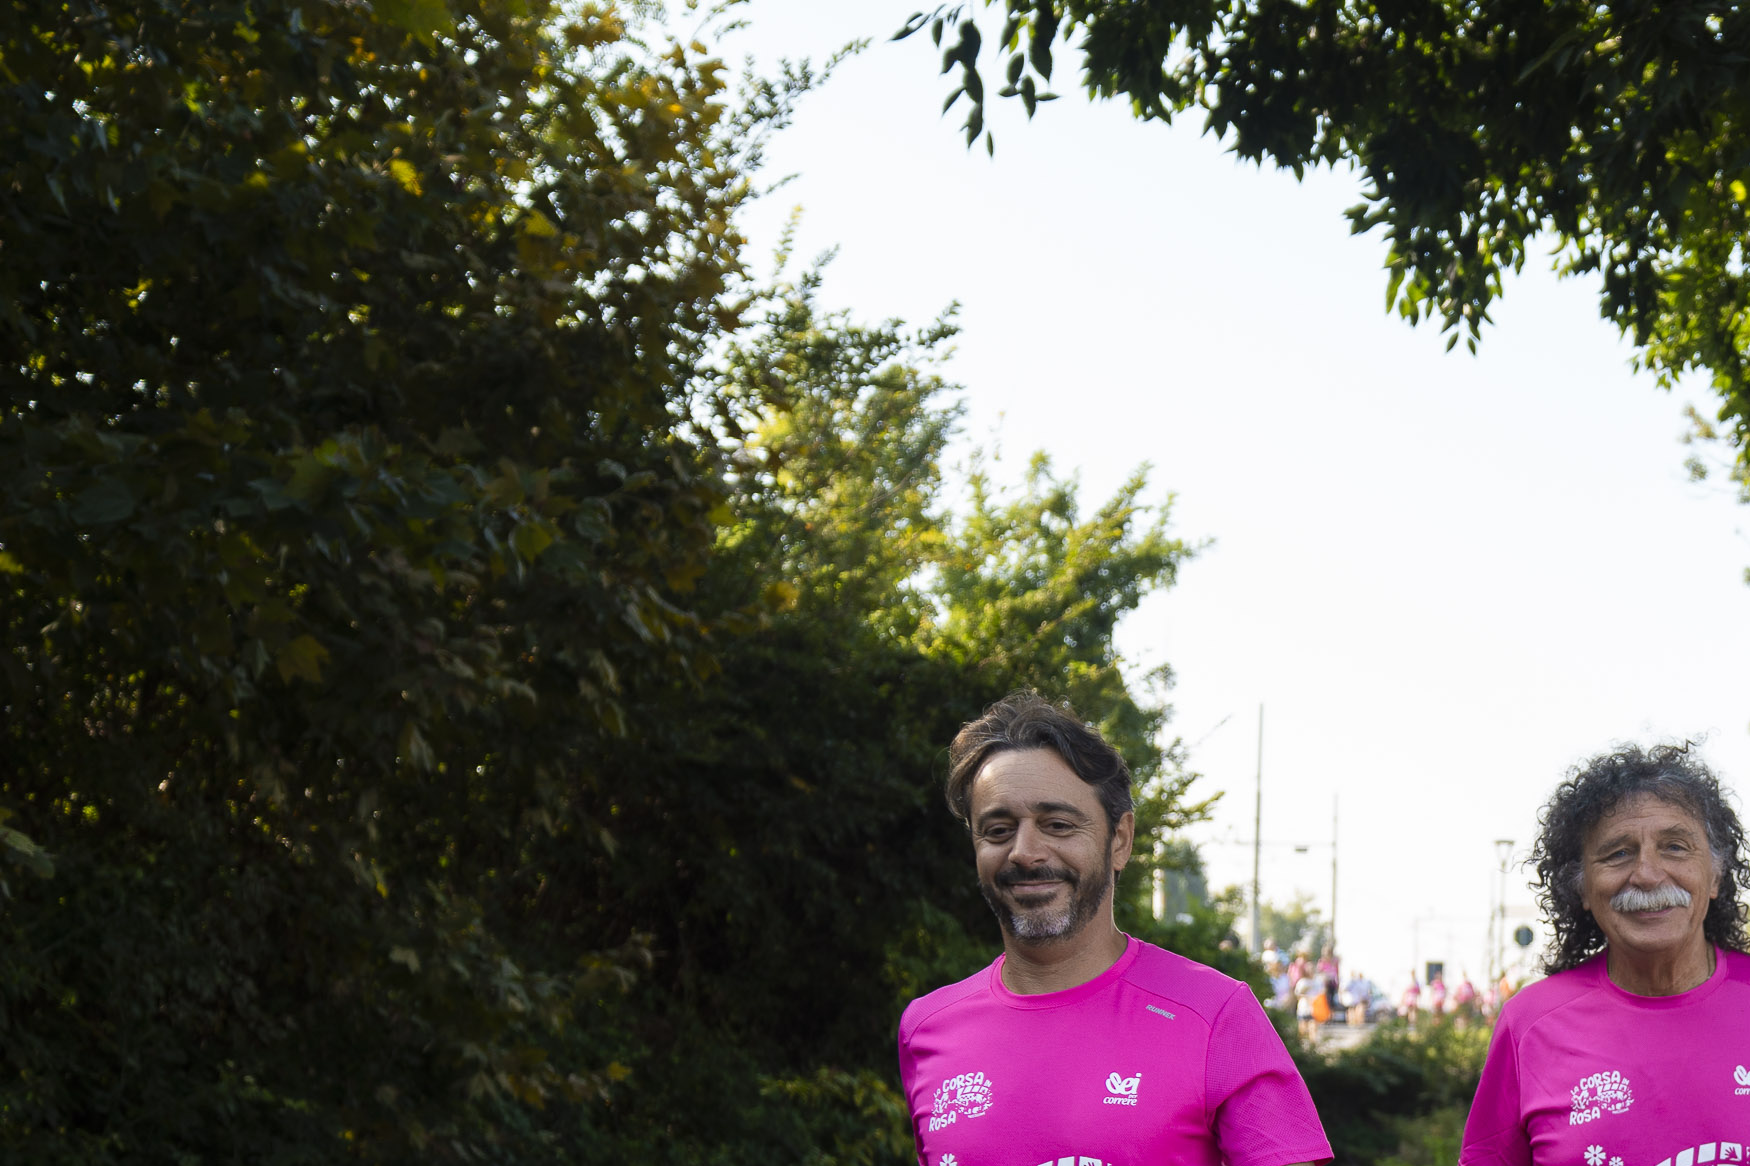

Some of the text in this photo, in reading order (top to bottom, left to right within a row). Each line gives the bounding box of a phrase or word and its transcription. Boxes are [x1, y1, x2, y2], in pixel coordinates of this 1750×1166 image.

[942, 1071, 985, 1093] CORSA
[1580, 1070, 1621, 1091] CORSA
[1103, 1096, 1138, 1106] correre
[928, 1110, 957, 1132] ROSA
[1569, 1106, 1601, 1126] ROSA
